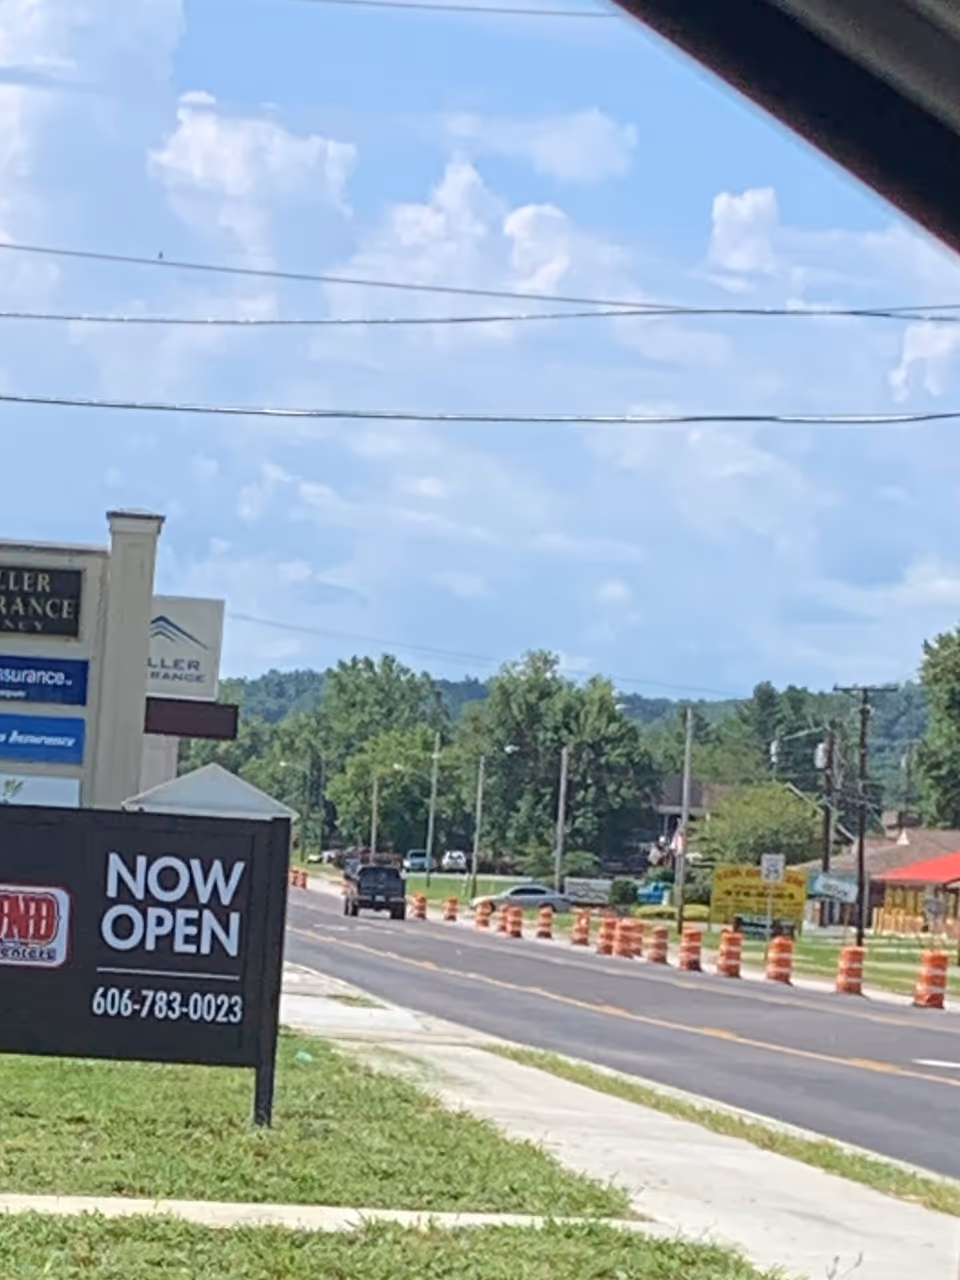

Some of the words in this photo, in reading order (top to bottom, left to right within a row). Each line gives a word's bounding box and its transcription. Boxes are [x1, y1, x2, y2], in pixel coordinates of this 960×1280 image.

[147, 657, 200, 672] LLER
[7, 729, 77, 748] Insurance
[106, 851, 246, 907] NOW
[100, 903, 241, 957] OPEN
[92, 986, 243, 1023] 606-783-0023
